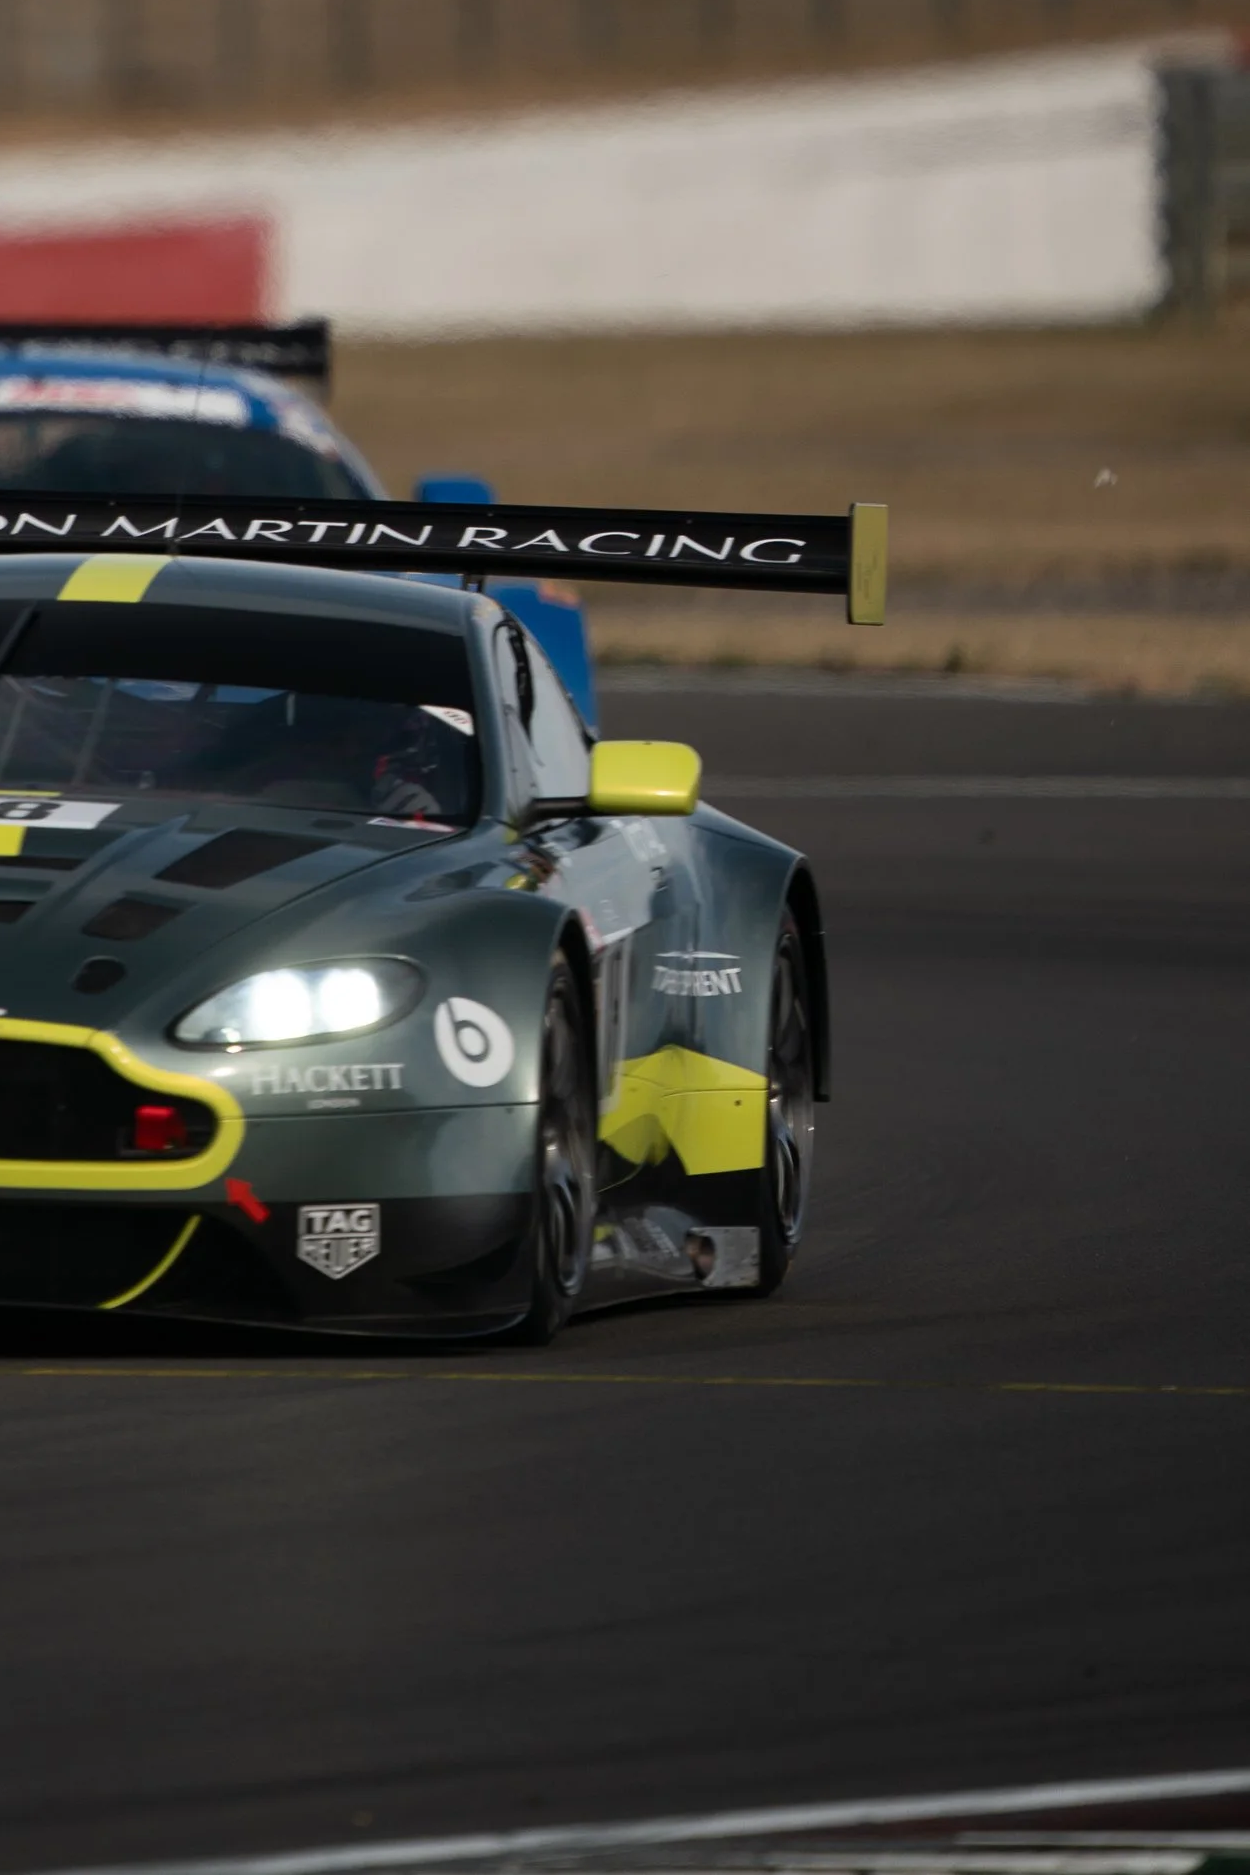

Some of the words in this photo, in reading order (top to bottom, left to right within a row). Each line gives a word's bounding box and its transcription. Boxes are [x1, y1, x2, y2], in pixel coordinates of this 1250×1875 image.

[100, 516, 433, 546] MARTIN
[457, 526, 806, 564] RACING
[251, 1063, 405, 1095] HACKETT
[307, 1209, 372, 1232] TAG
